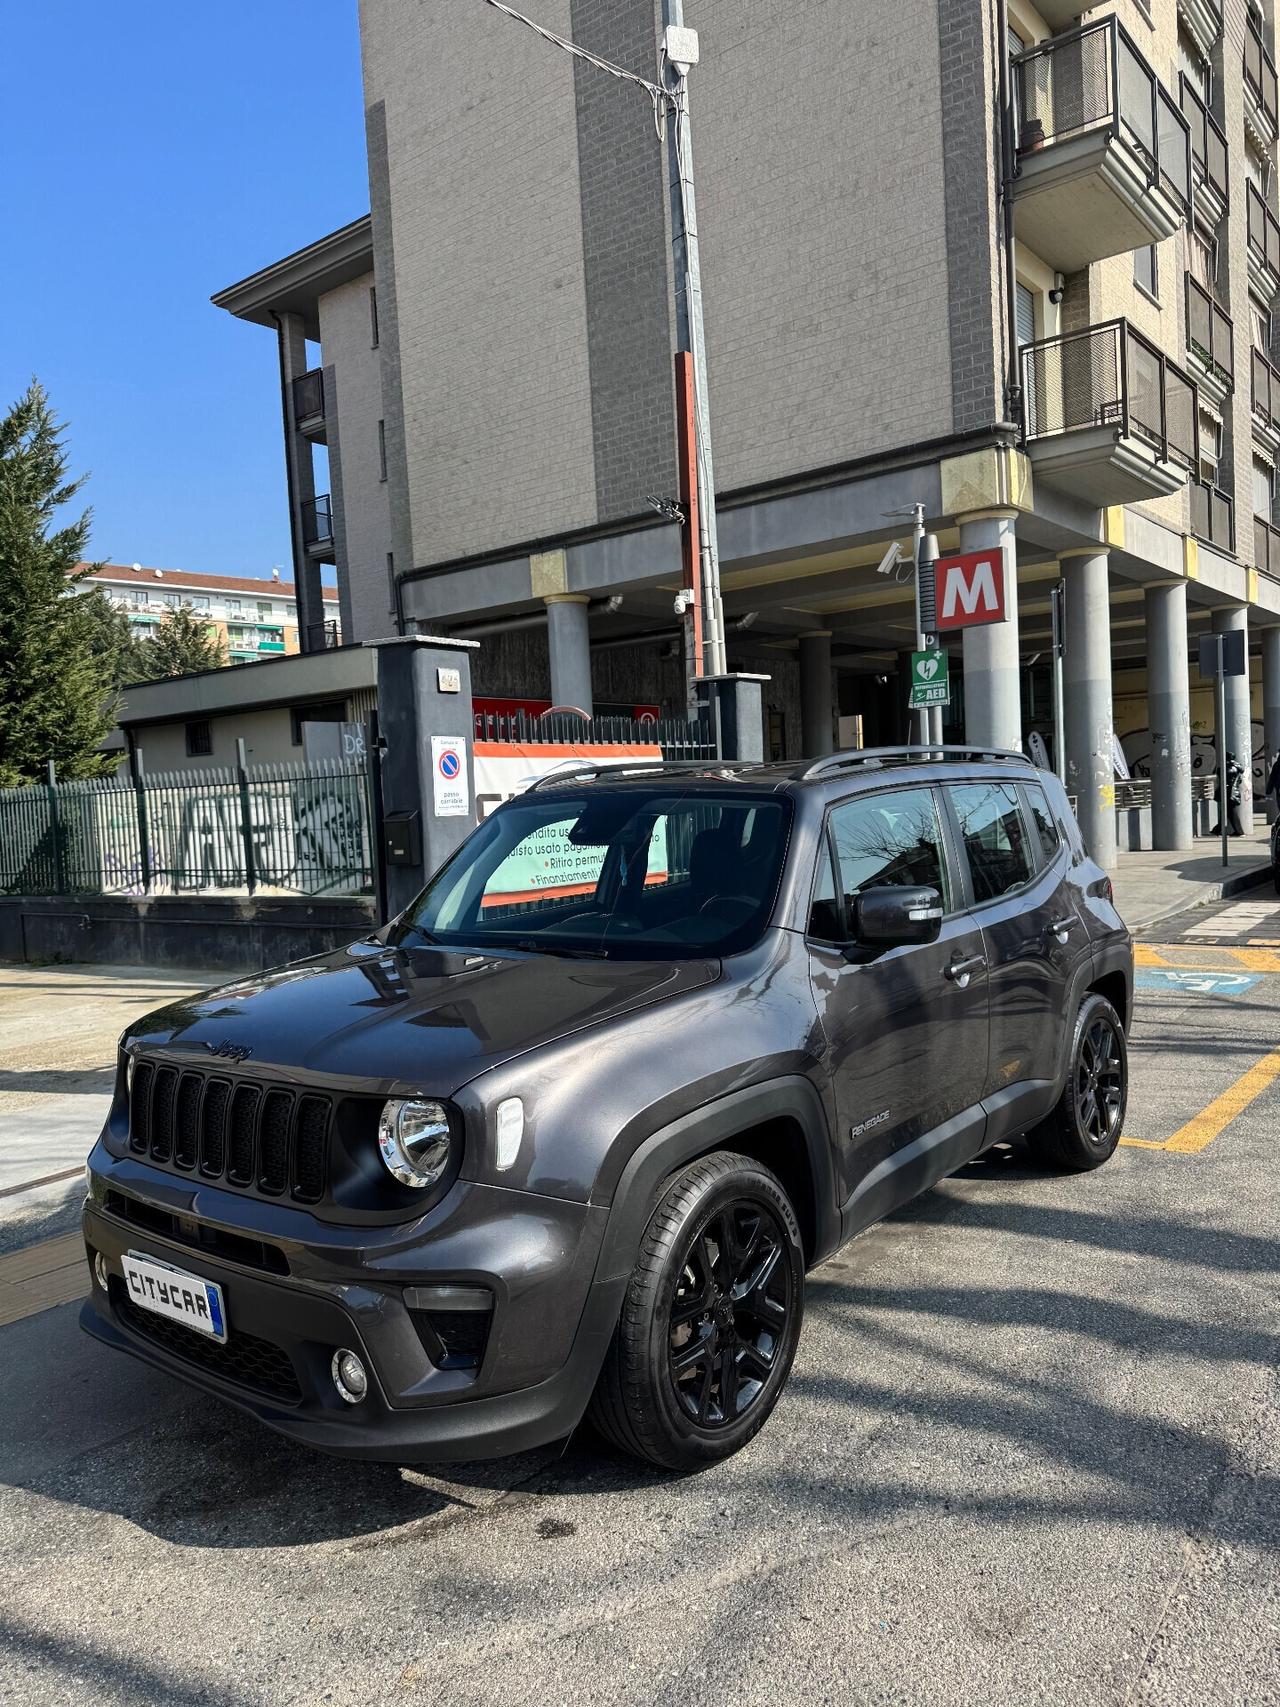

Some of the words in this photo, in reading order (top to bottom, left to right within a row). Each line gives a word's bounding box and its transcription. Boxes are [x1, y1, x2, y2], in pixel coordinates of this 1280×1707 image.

[942, 562, 999, 618] M
[927, 688, 945, 700] AED
[535, 843, 561, 854] usato
[550, 857, 573, 869] Ritiro
[535, 868, 598, 885] Finanziamenti
[209, 1039, 253, 1064] Jeep
[851, 1109, 890, 1139] RENEGADE
[129, 1270, 210, 1320] CITYCAR
